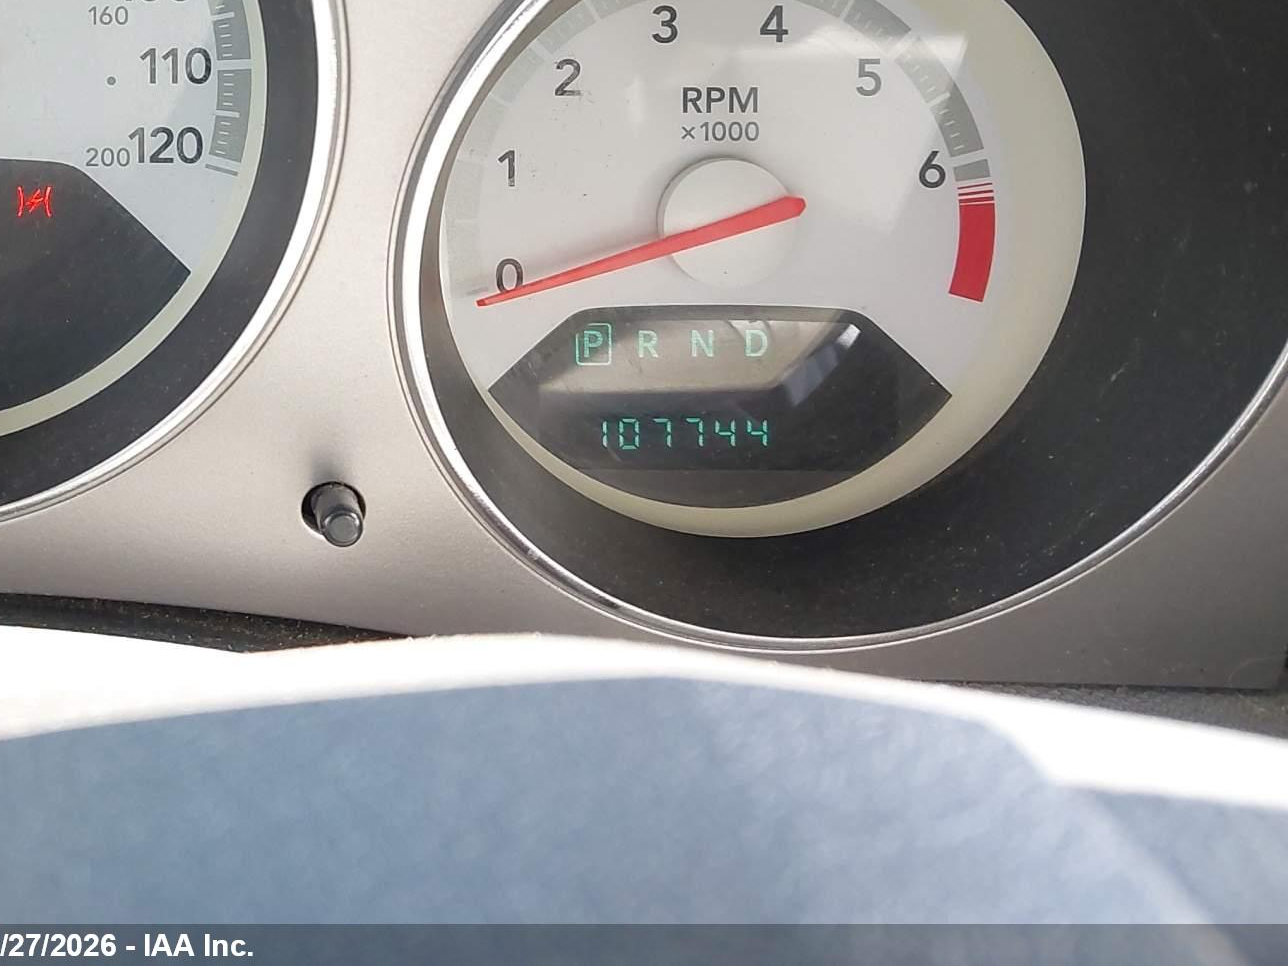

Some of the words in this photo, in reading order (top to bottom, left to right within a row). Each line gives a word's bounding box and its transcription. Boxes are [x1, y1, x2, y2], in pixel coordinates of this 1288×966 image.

[88, 6, 129, 26] 160
[652, 5, 679, 44] 3
[759, 5, 789, 43] 4
[139, 47, 212, 84] 110
[554, 59, 583, 96] 2
[856, 58, 882, 97] 5
[682, 86, 759, 114] RPM
[85, 147, 131, 167] 200
[128, 126, 203, 165] 120
[497, 150, 517, 187] 1
[918, 150, 947, 189] 6
[495, 258, 524, 294] 0
[583, 330, 604, 358] P
[638, 330, 659, 358] R
[691, 329, 715, 357] N
[745, 329, 769, 357] D
[602, 418, 768, 450] 107744
